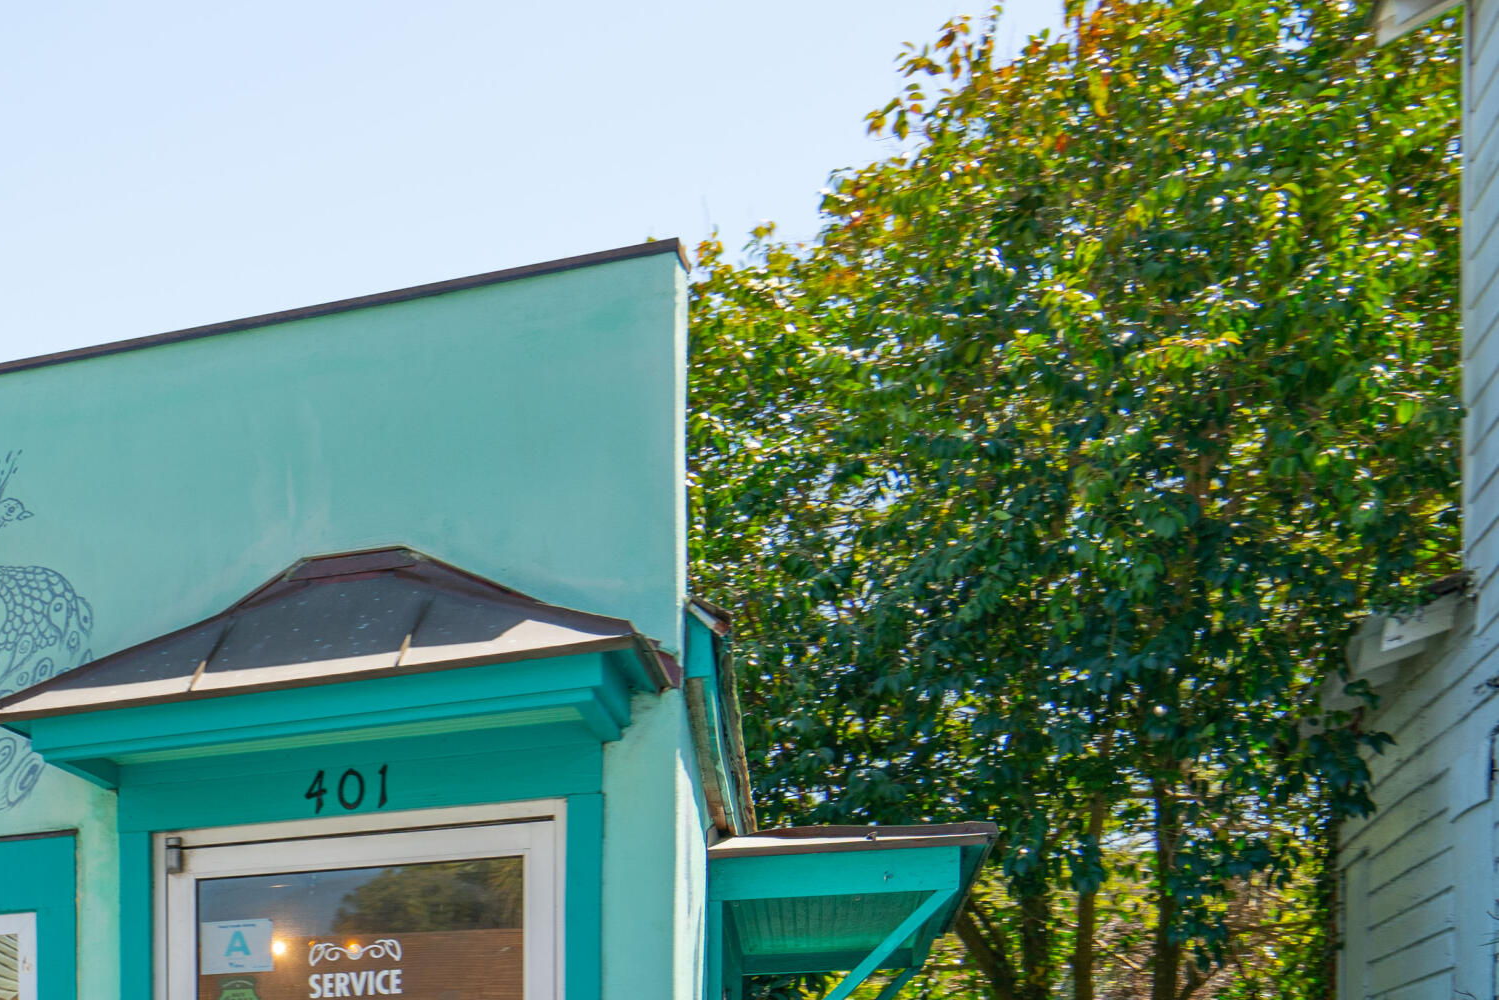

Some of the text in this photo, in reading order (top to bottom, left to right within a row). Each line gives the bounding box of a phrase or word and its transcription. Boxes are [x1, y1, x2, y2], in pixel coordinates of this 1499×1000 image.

[304, 763, 388, 815] 401
[224, 930, 251, 957] A
[308, 969, 403, 998] SERVICE
